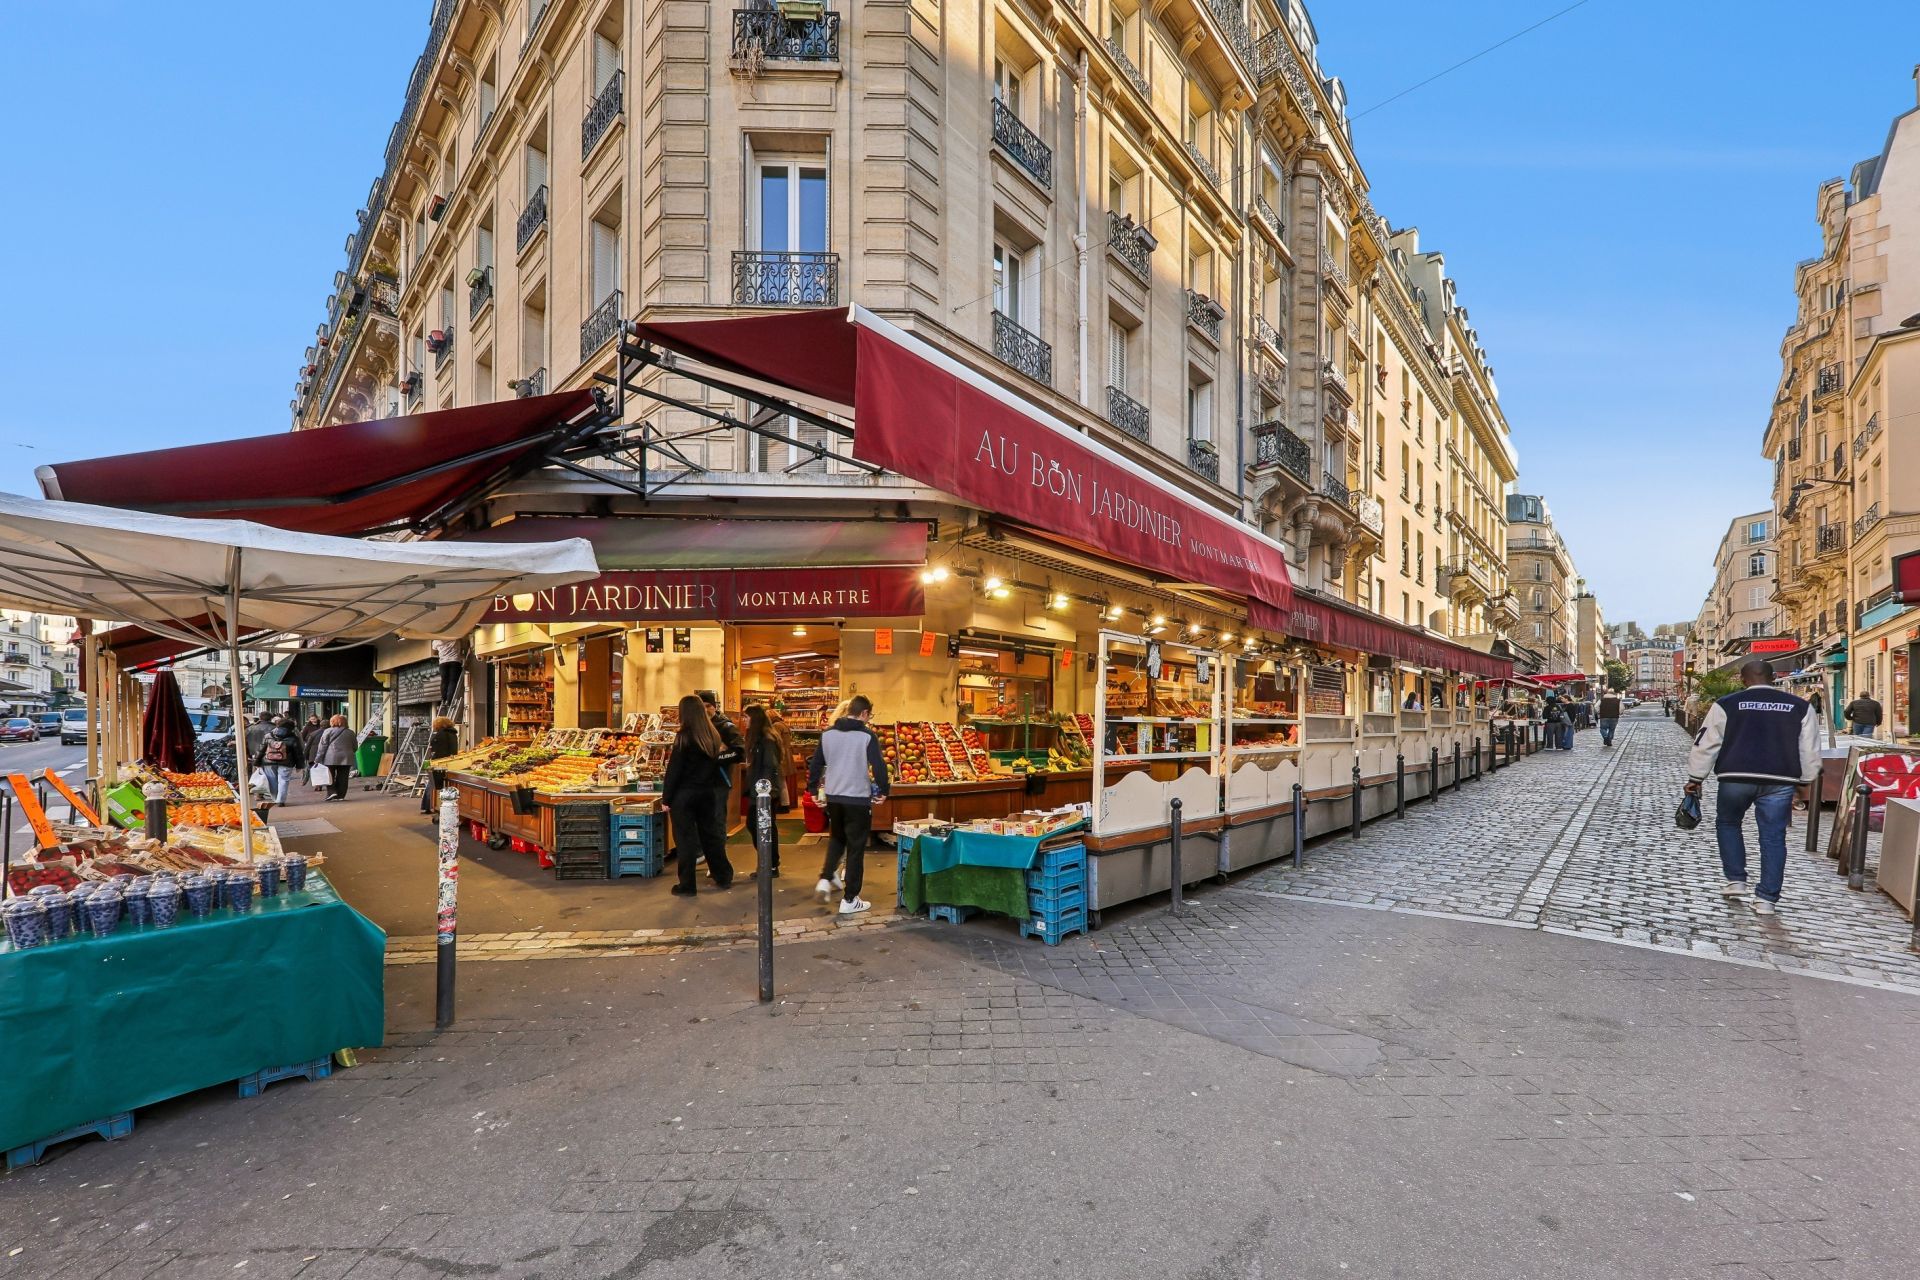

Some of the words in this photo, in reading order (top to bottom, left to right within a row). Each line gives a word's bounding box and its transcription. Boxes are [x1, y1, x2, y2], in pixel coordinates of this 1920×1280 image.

[974, 430, 1018, 475] AU
[1031, 452, 1083, 505] BON
[1090, 480, 1182, 548] JARDINIER
[1190, 539, 1262, 574] MONTMARTRE
[494, 587, 557, 612] BON
[570, 584, 717, 615] JARDINIER
[736, 589, 871, 607] MONTMARTRE
